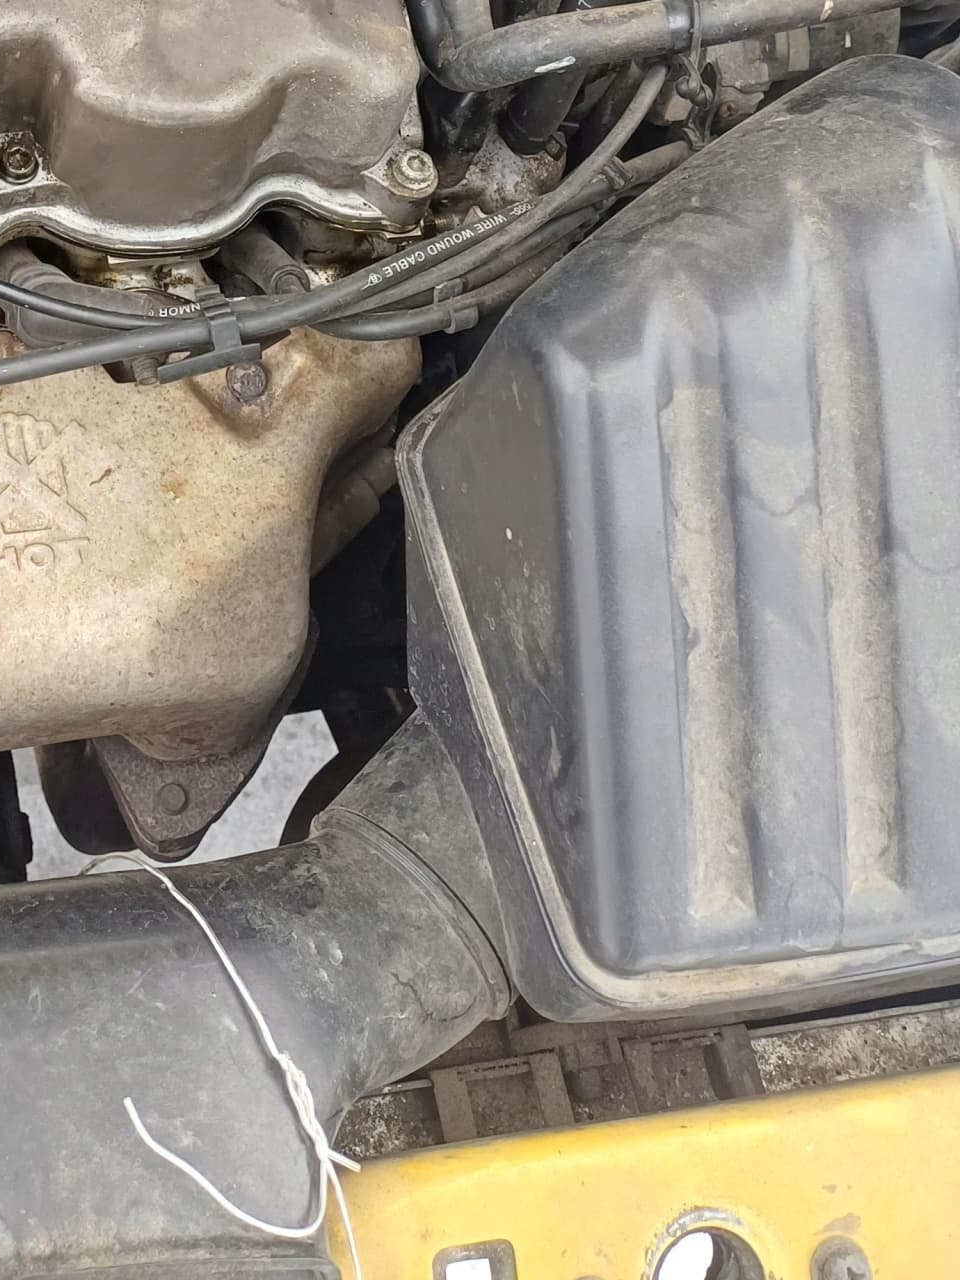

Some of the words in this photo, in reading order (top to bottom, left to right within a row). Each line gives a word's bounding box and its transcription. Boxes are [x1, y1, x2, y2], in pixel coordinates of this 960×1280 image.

[474, 214, 508, 236] WIRE
[426, 226, 474, 257] WOUND
[383, 248, 426, 278] CABLE
